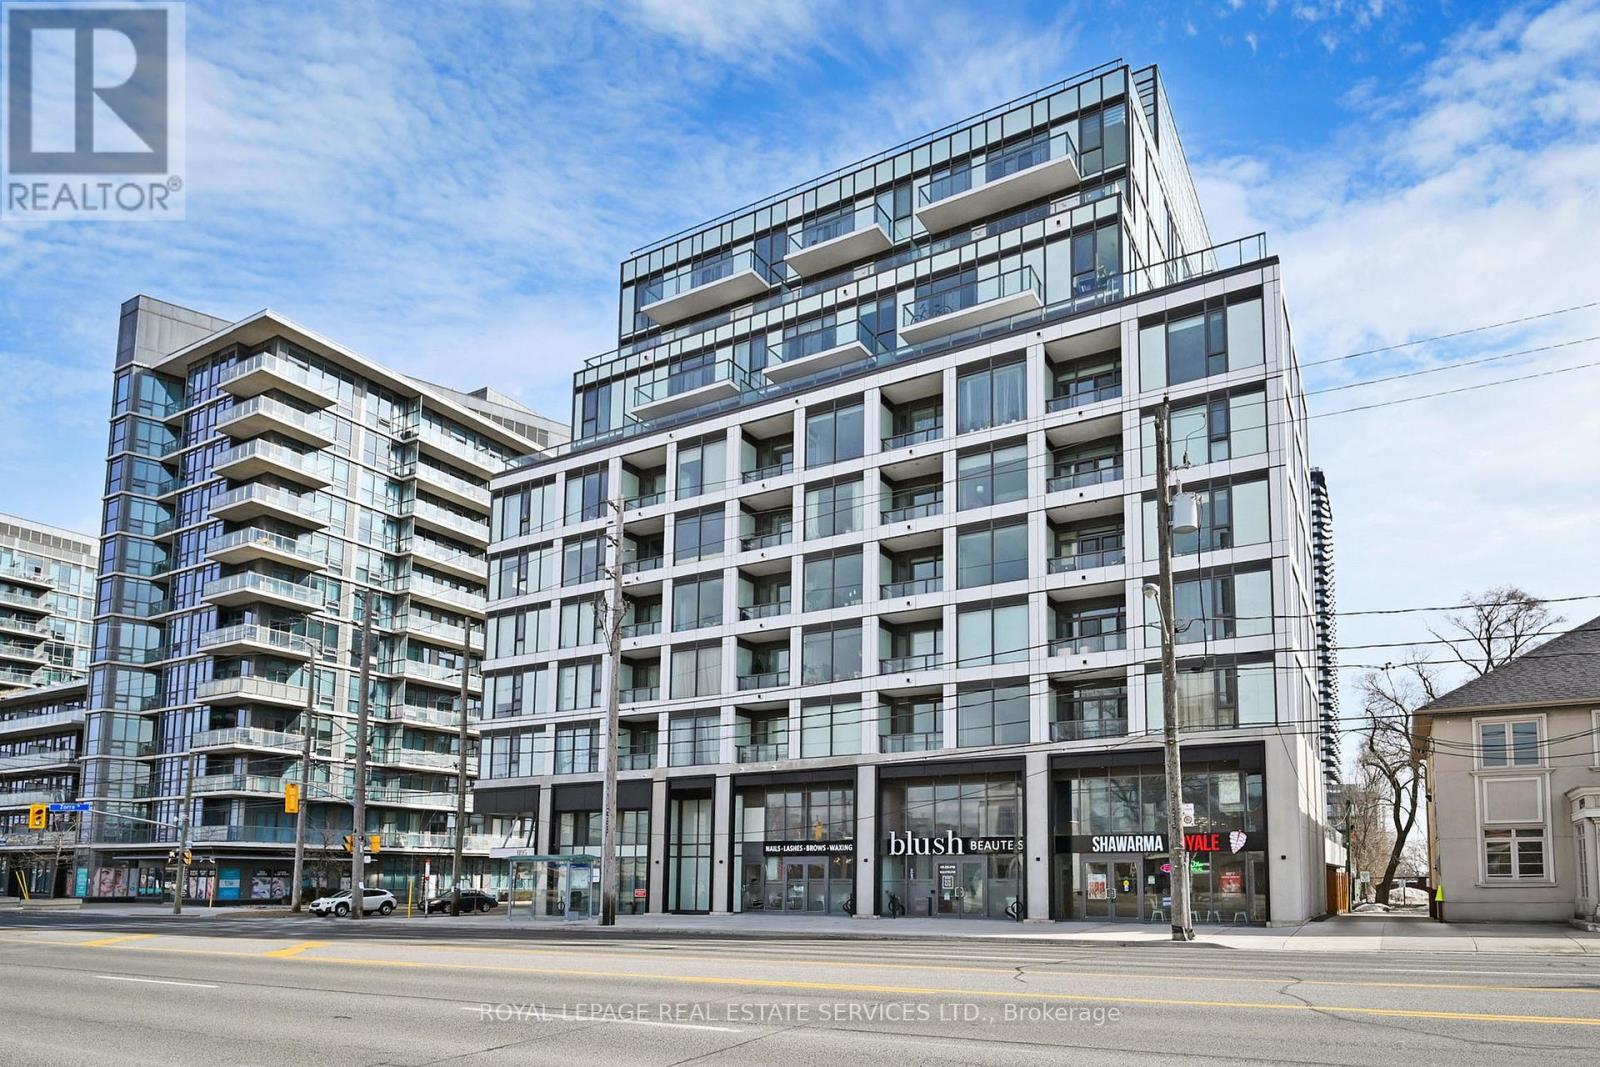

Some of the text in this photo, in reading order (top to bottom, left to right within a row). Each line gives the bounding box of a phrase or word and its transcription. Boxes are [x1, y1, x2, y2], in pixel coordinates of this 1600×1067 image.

[889, 830, 964, 855] blush
[970, 840, 1014, 851] BEAUTE
[1092, 834, 1221, 852] SHAWARMA YALE
